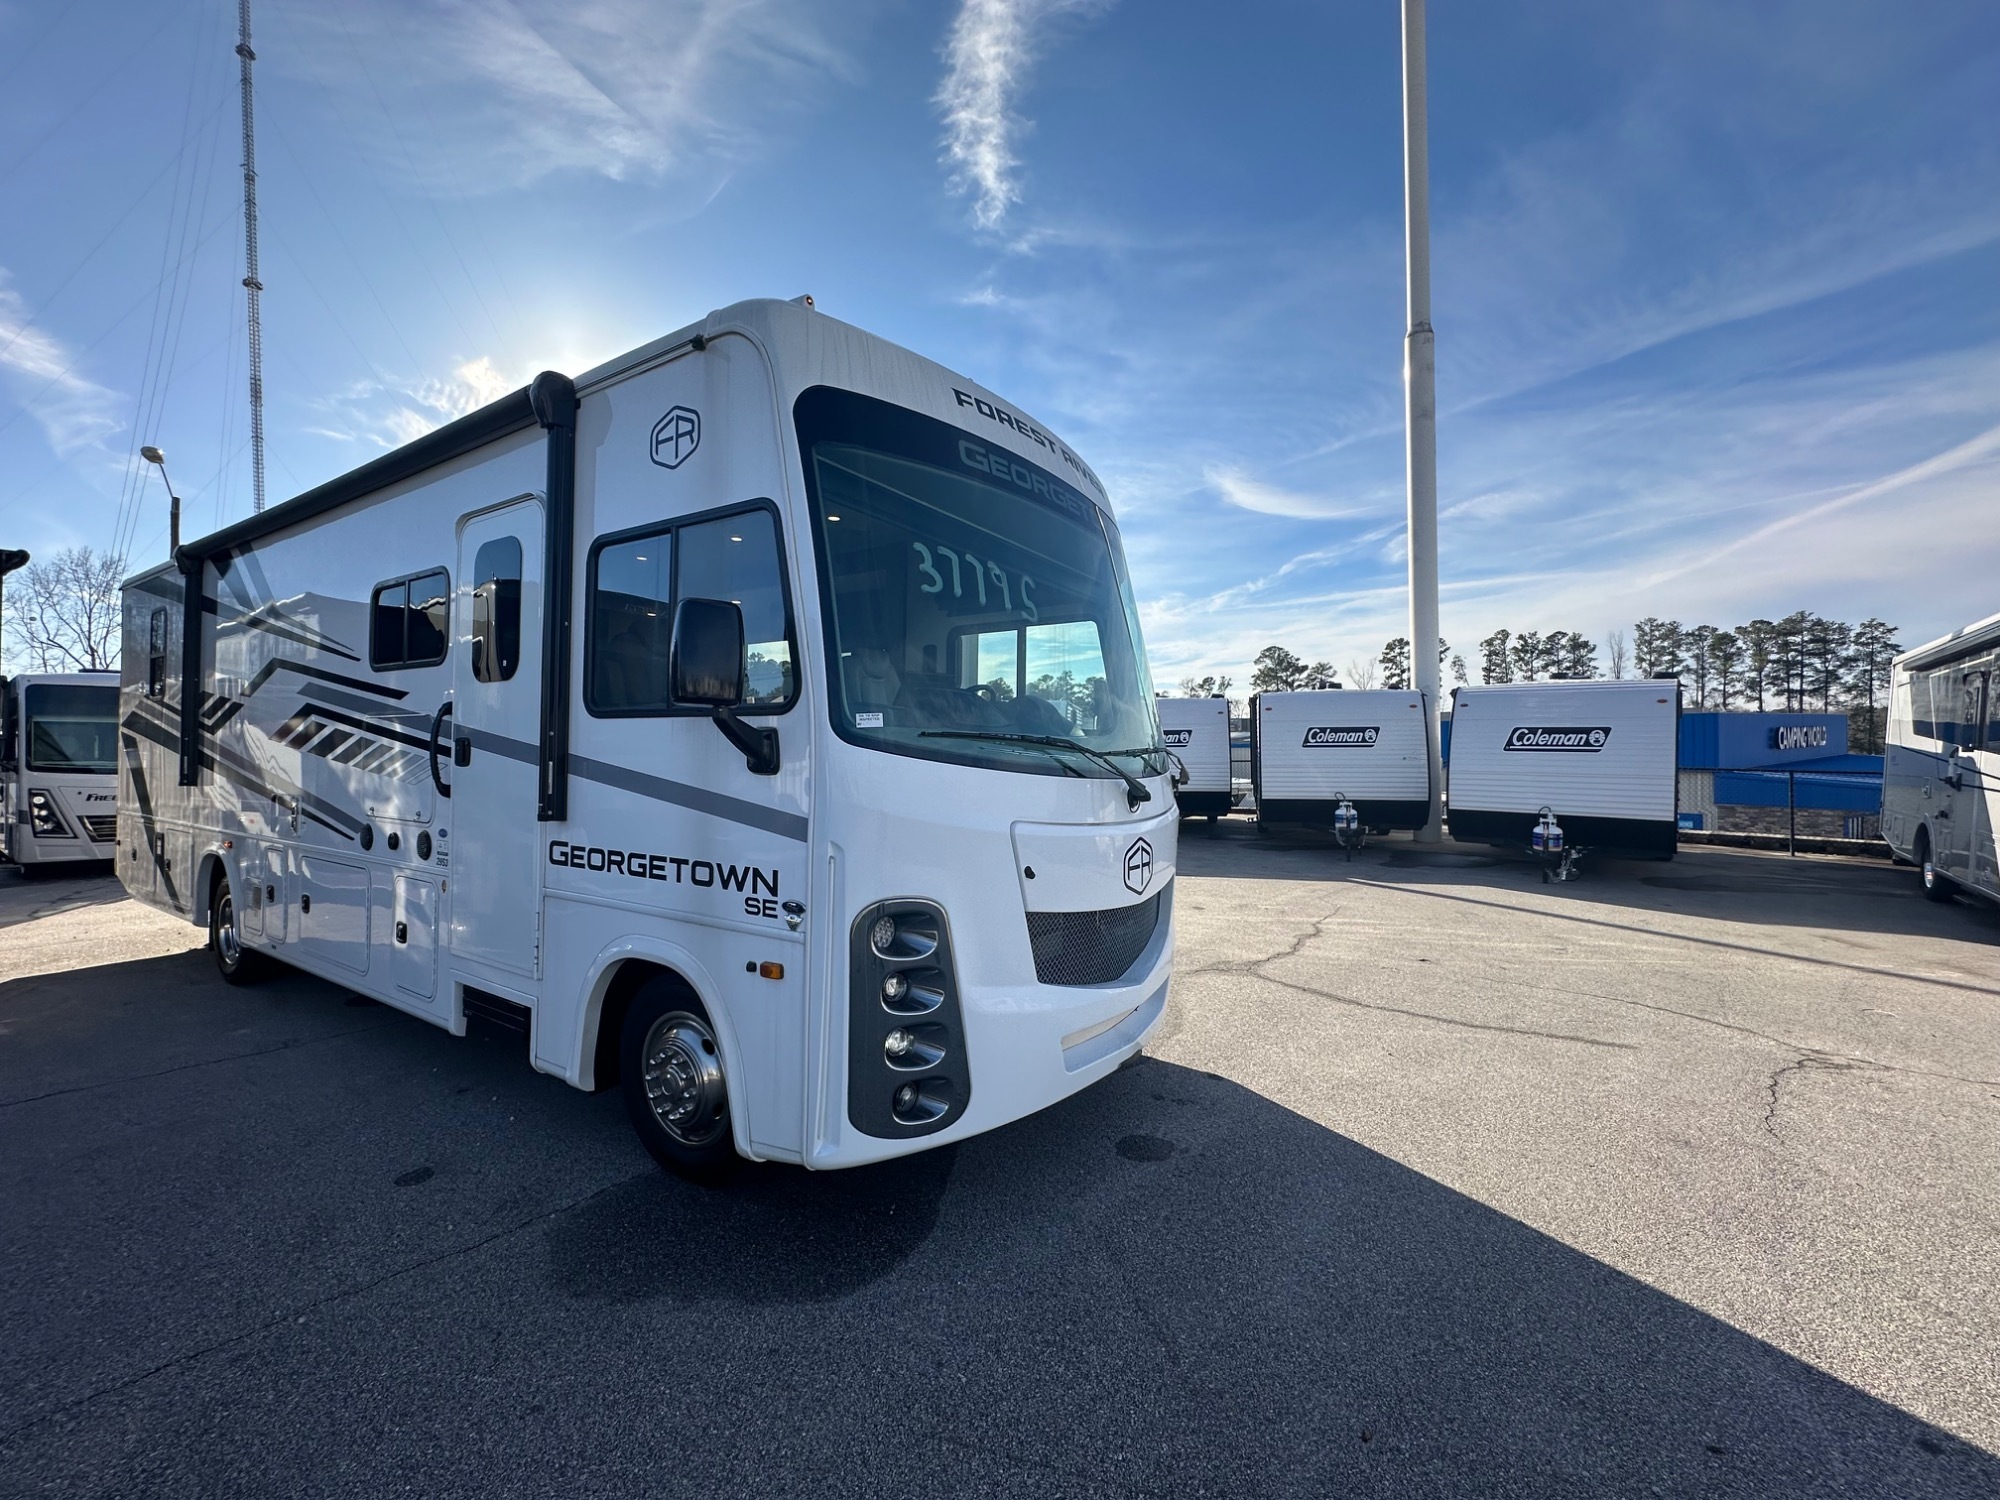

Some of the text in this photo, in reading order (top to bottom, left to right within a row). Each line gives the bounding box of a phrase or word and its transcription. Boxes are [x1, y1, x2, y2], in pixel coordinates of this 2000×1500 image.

[951, 387, 1056, 454] FOREST
[1308, 728, 1363, 743] Coleman
[1512, 728, 1587, 746] Coleman
[1779, 726, 1827, 750] CAMPING WORLD
[549, 840, 778, 898] GEORGETOWN
[744, 897, 778, 919] SE
